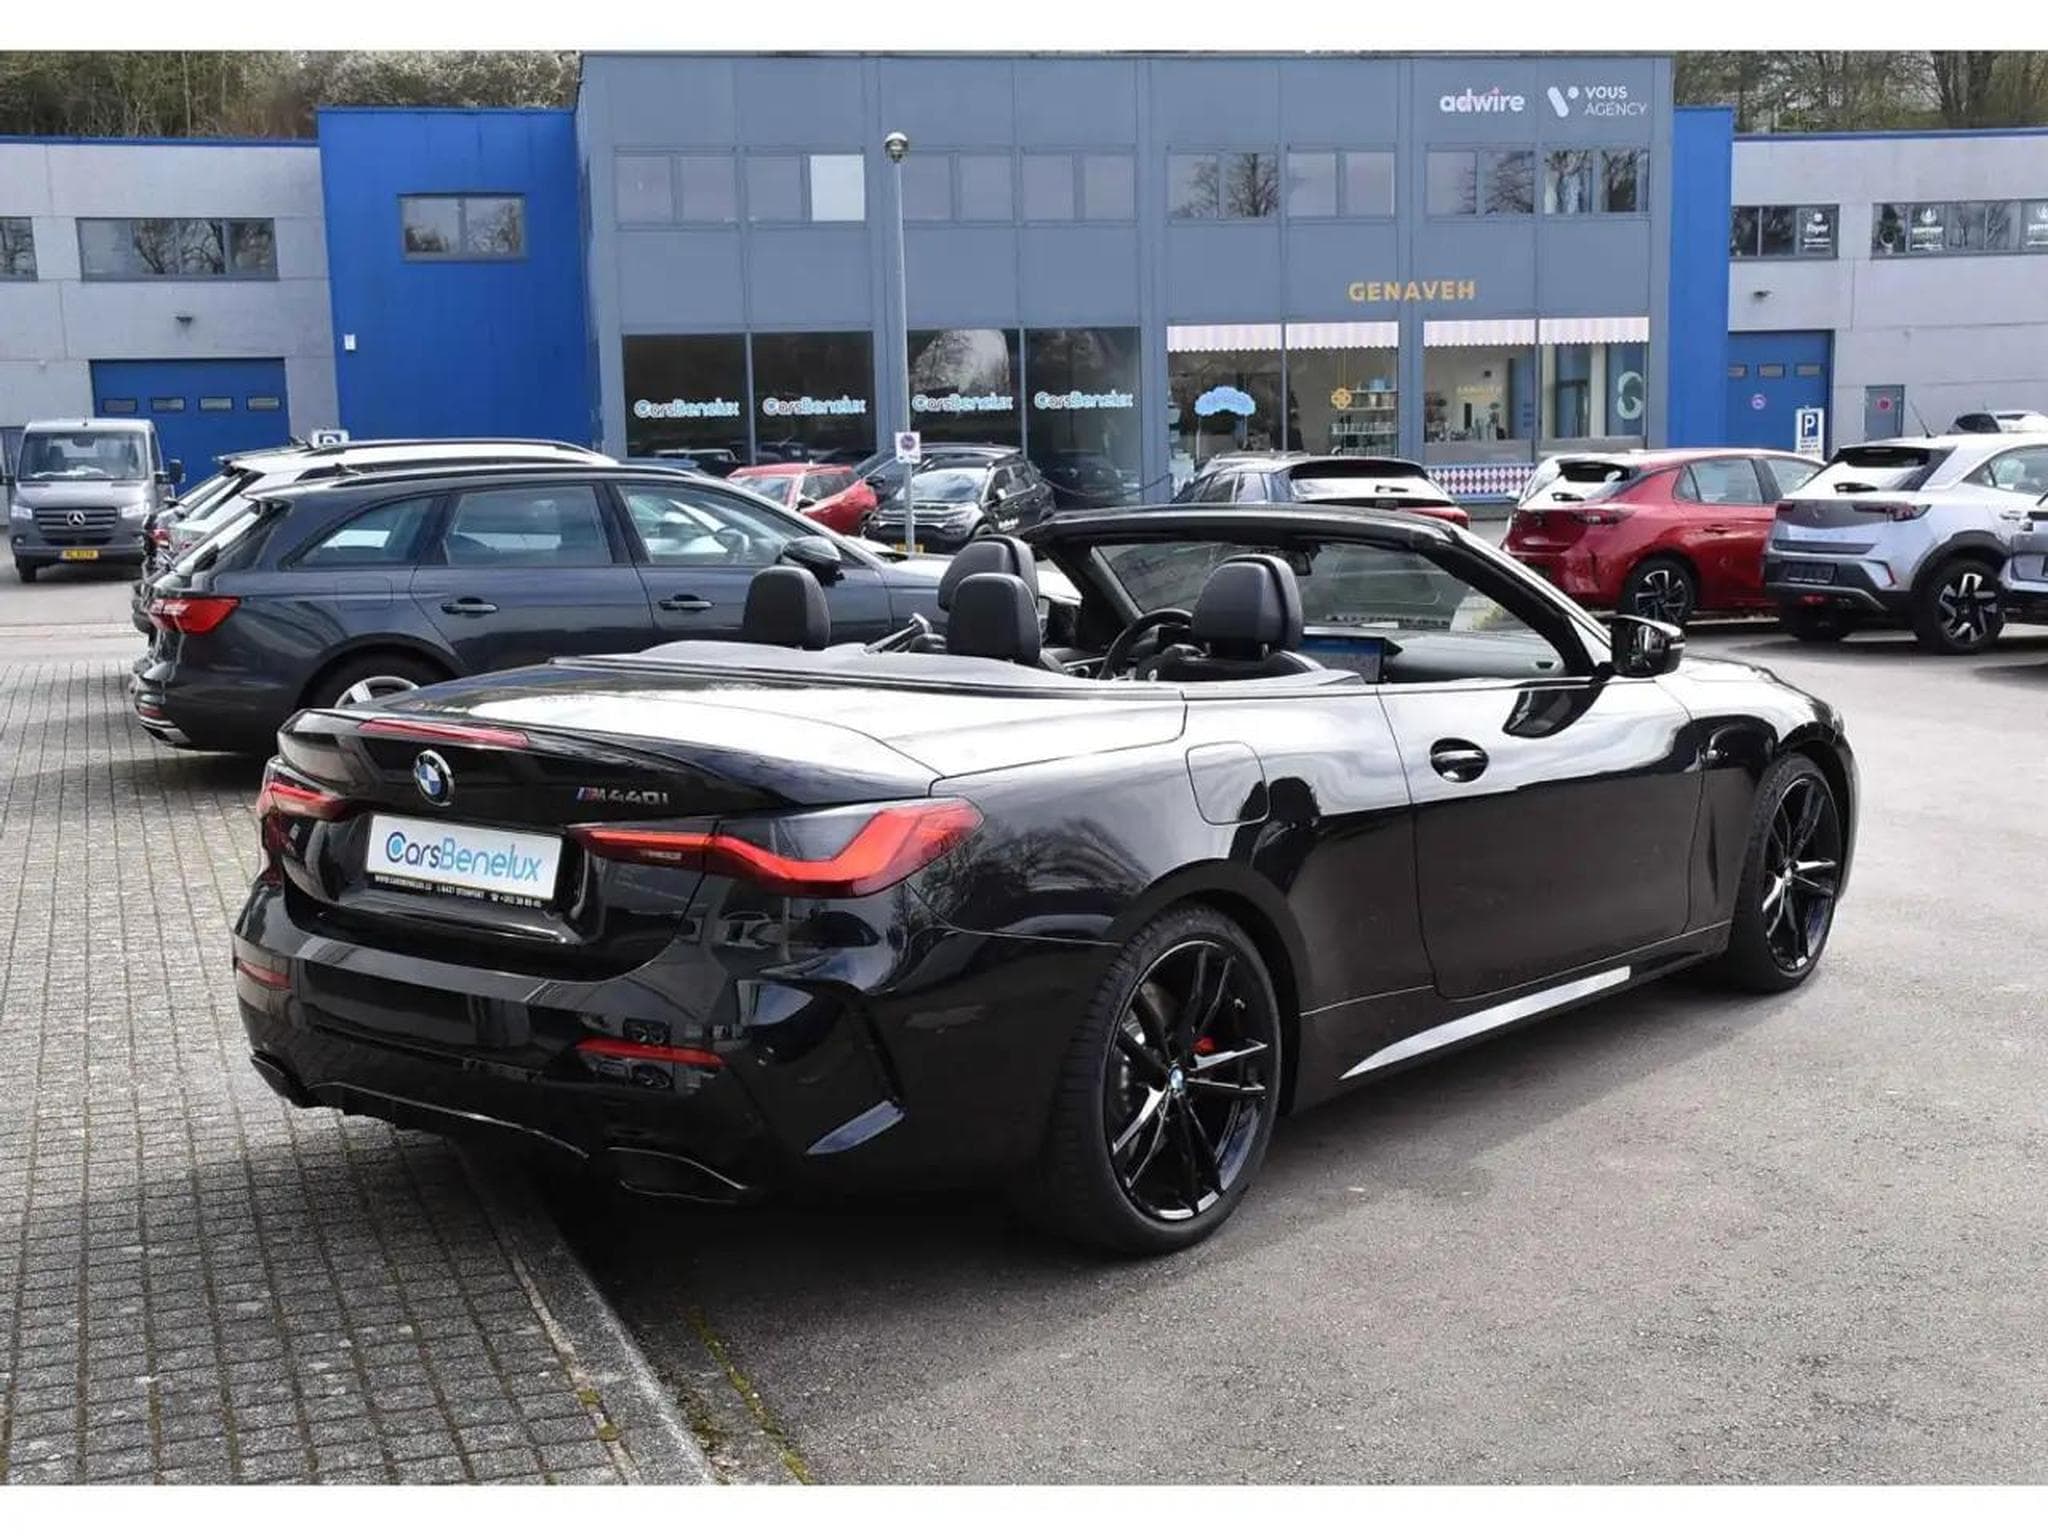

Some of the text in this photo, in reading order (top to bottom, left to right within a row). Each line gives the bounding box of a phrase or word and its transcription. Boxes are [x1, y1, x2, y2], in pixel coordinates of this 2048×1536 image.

[1440, 87, 1525, 112] adwire
[1585, 86, 1628, 99] VOUS
[1585, 102, 1647, 117] AGENCY
[1348, 280, 1476, 301] GENAVEH
[634, 398, 740, 418] CarsBenelux
[762, 395, 867, 416] CarsBenelux
[911, 392, 1014, 412] CarsBenelux
[1034, 389, 1134, 410] CarsBenelux
[1804, 414, 1816, 436] P
[386, 831, 543, 882] CarsBenelux
